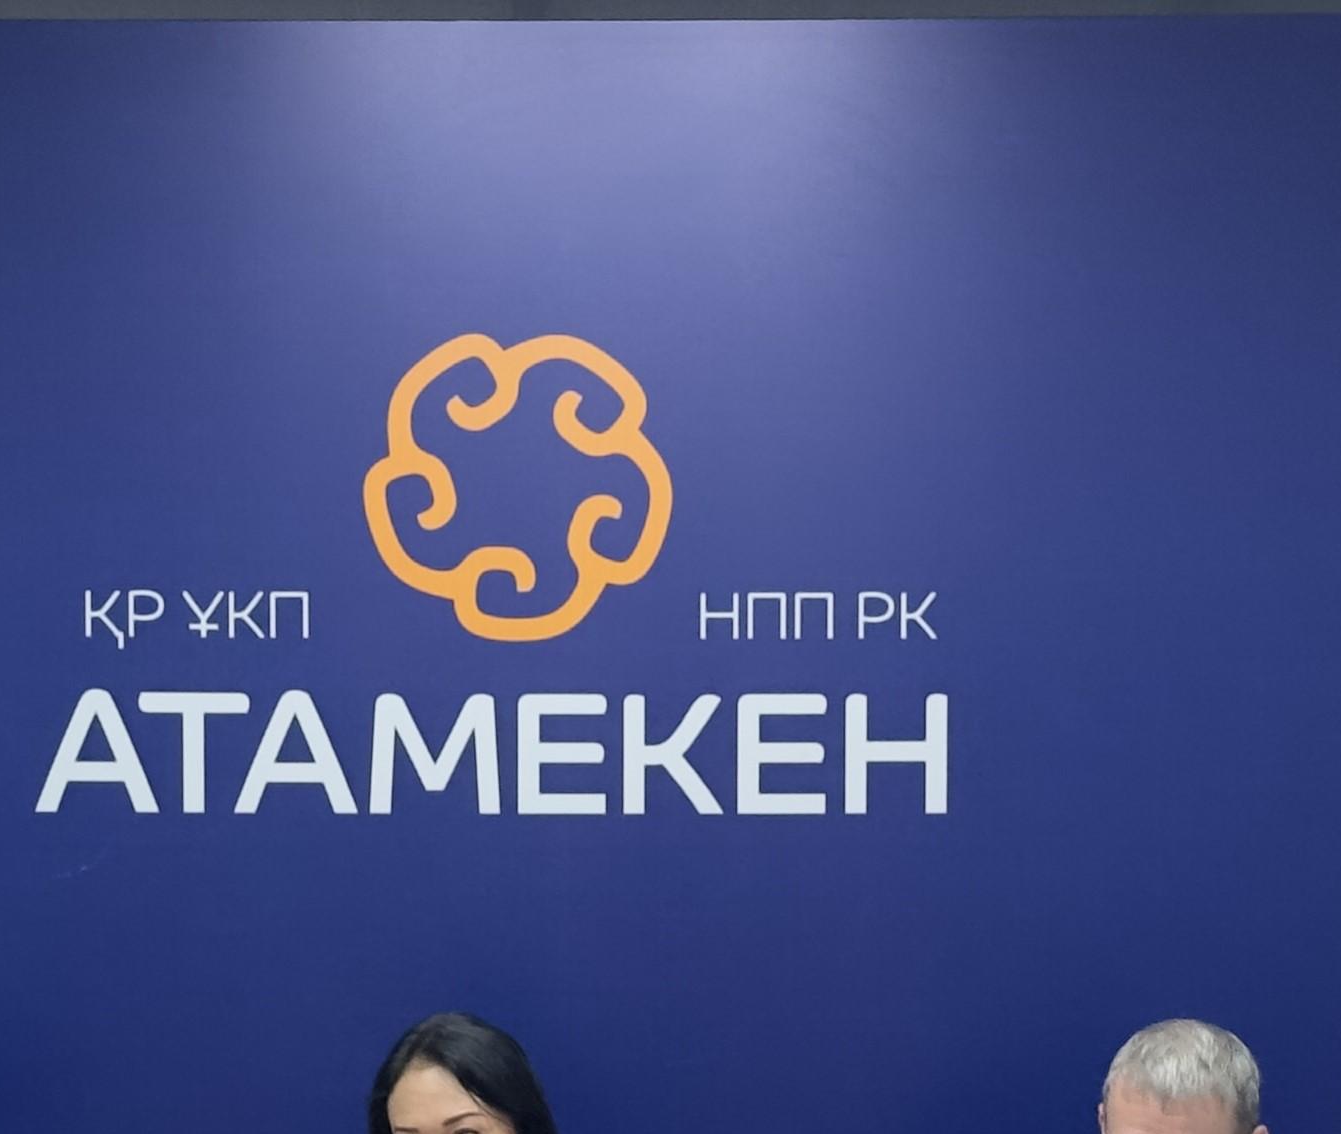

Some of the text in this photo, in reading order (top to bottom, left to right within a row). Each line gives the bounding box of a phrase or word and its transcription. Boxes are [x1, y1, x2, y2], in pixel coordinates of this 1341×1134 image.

[84, 591, 164, 649] ҚР
[700, 591, 938, 640] НПП РК
[35, 688, 948, 815] АТАМЕКЕН
